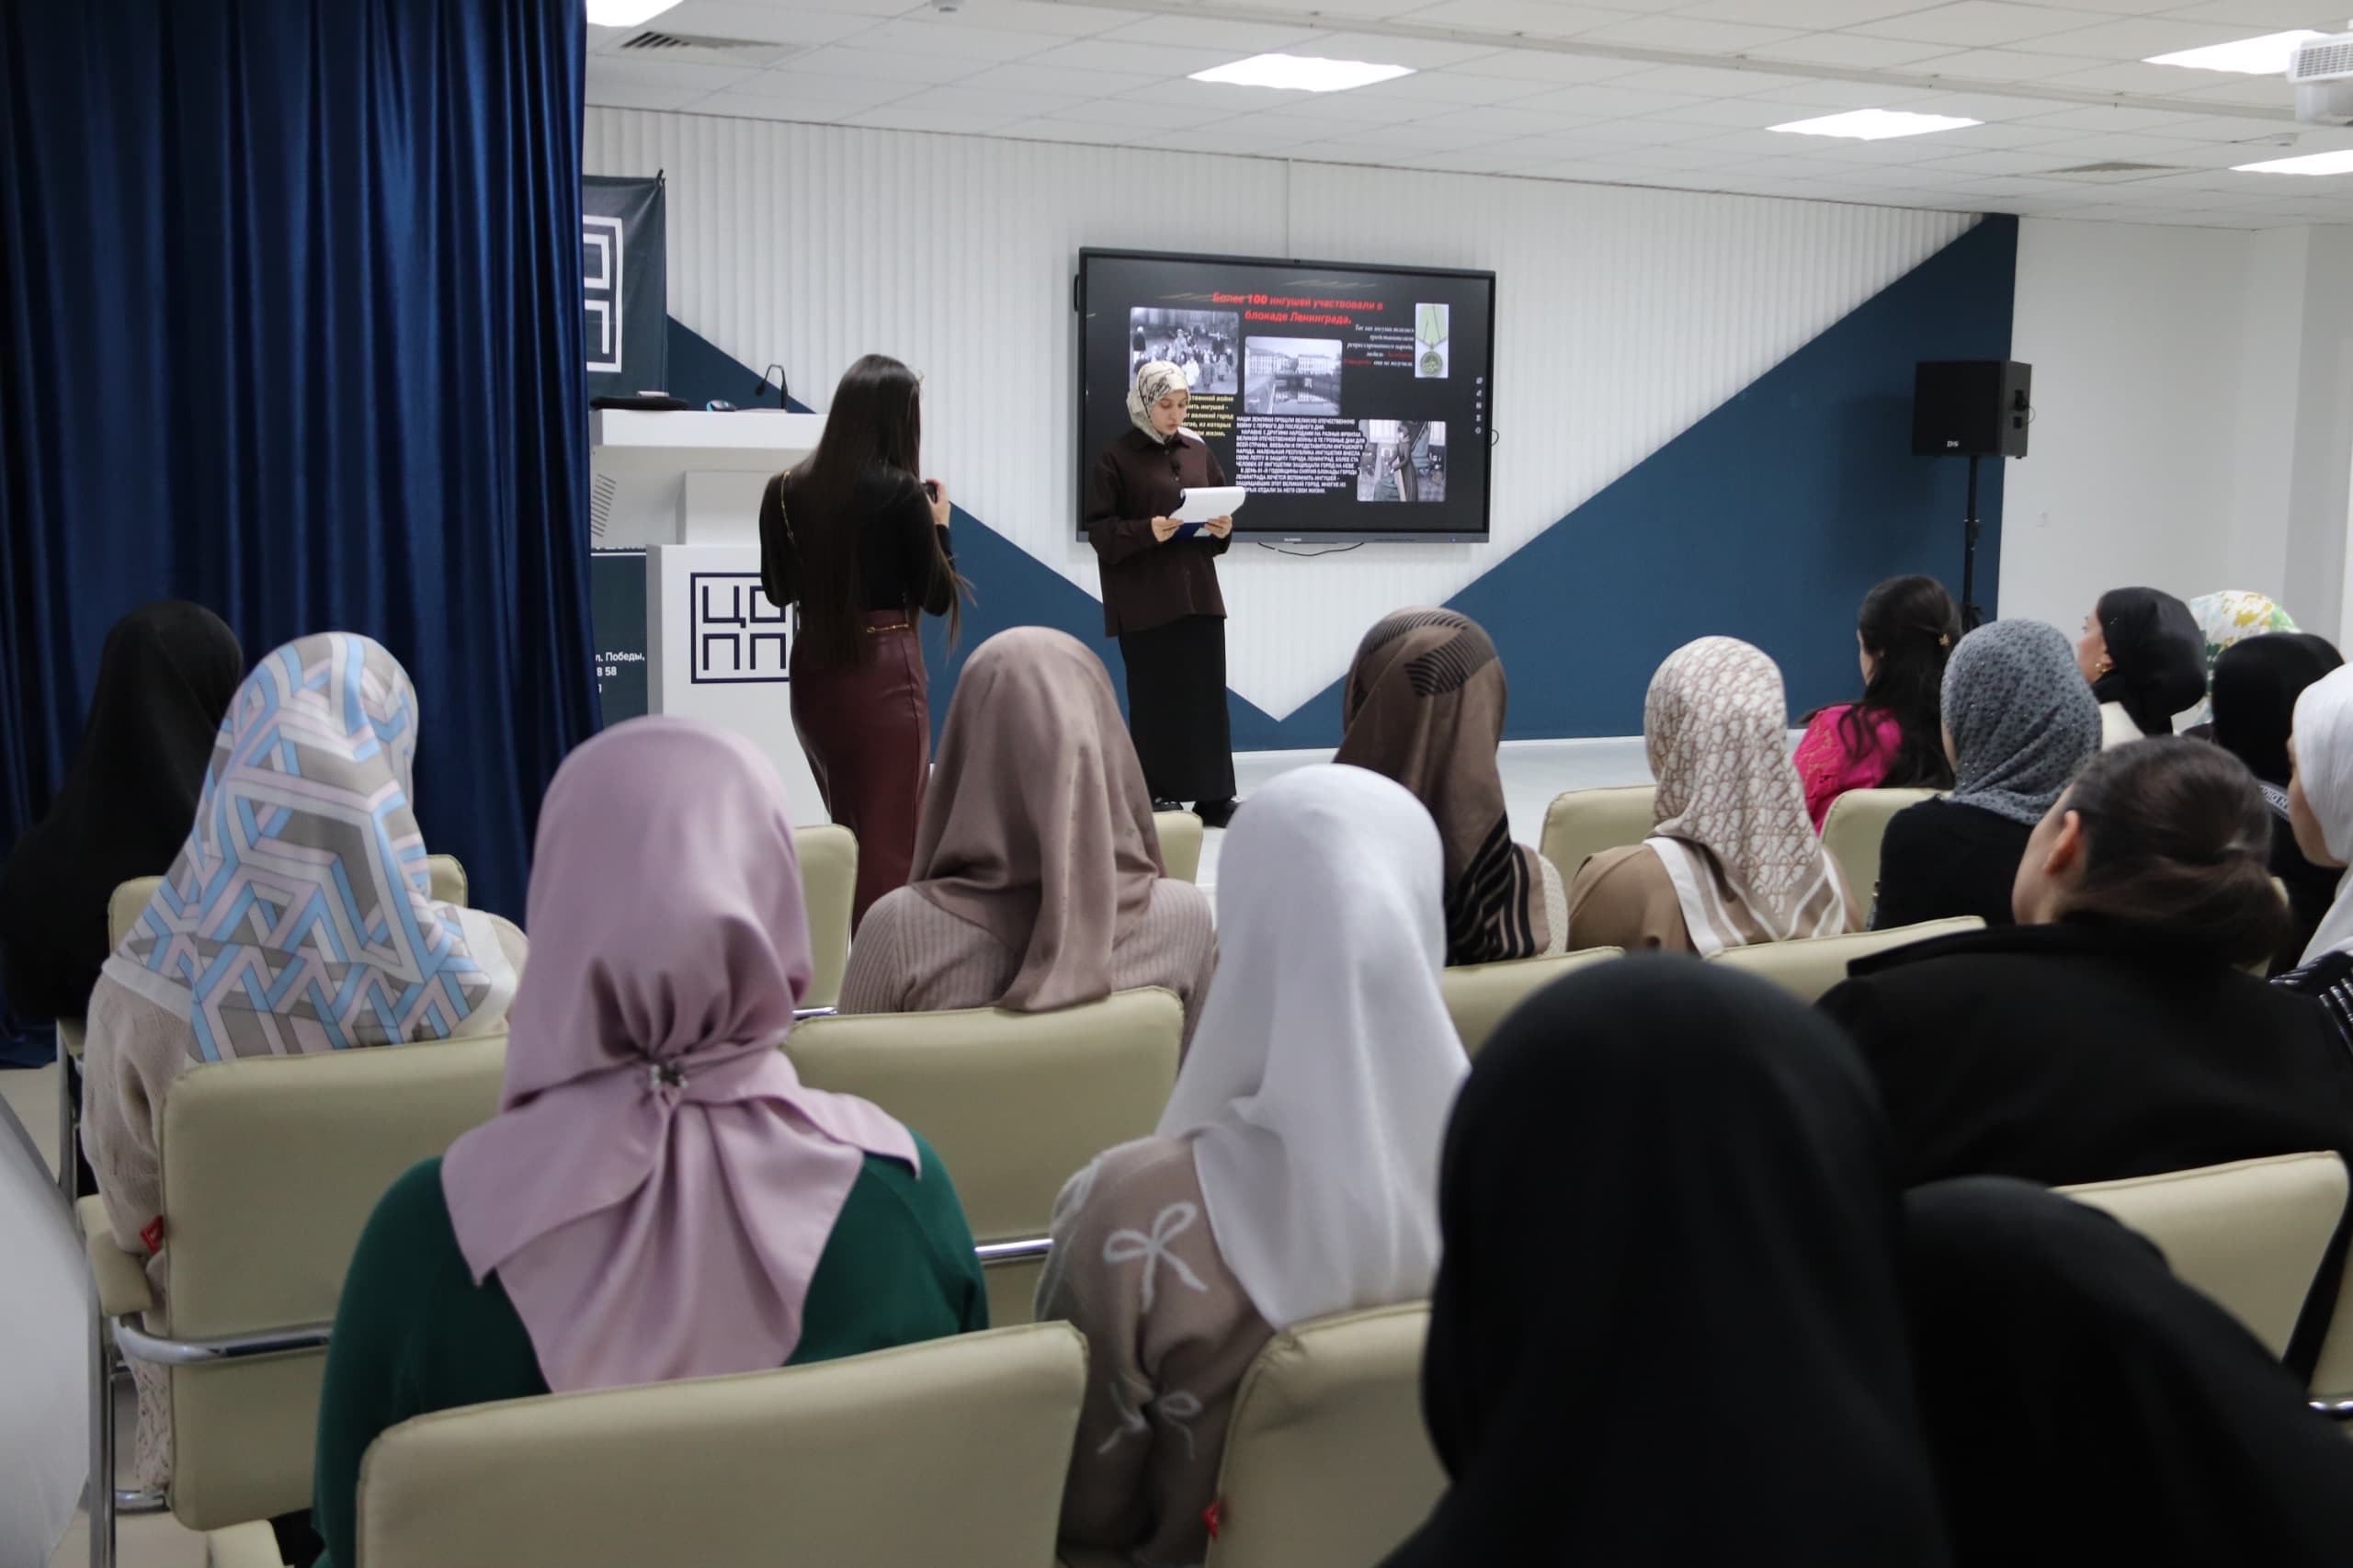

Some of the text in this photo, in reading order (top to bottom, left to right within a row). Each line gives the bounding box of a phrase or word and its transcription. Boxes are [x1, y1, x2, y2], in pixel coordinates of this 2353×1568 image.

[1212, 291, 1383, 311] Более 100 ингушей участвовали в
[1245, 309, 1352, 324] блокаде Ленинграда.
[596, 651, 645, 663] л. Победы,
[605, 665, 618, 676] 58
